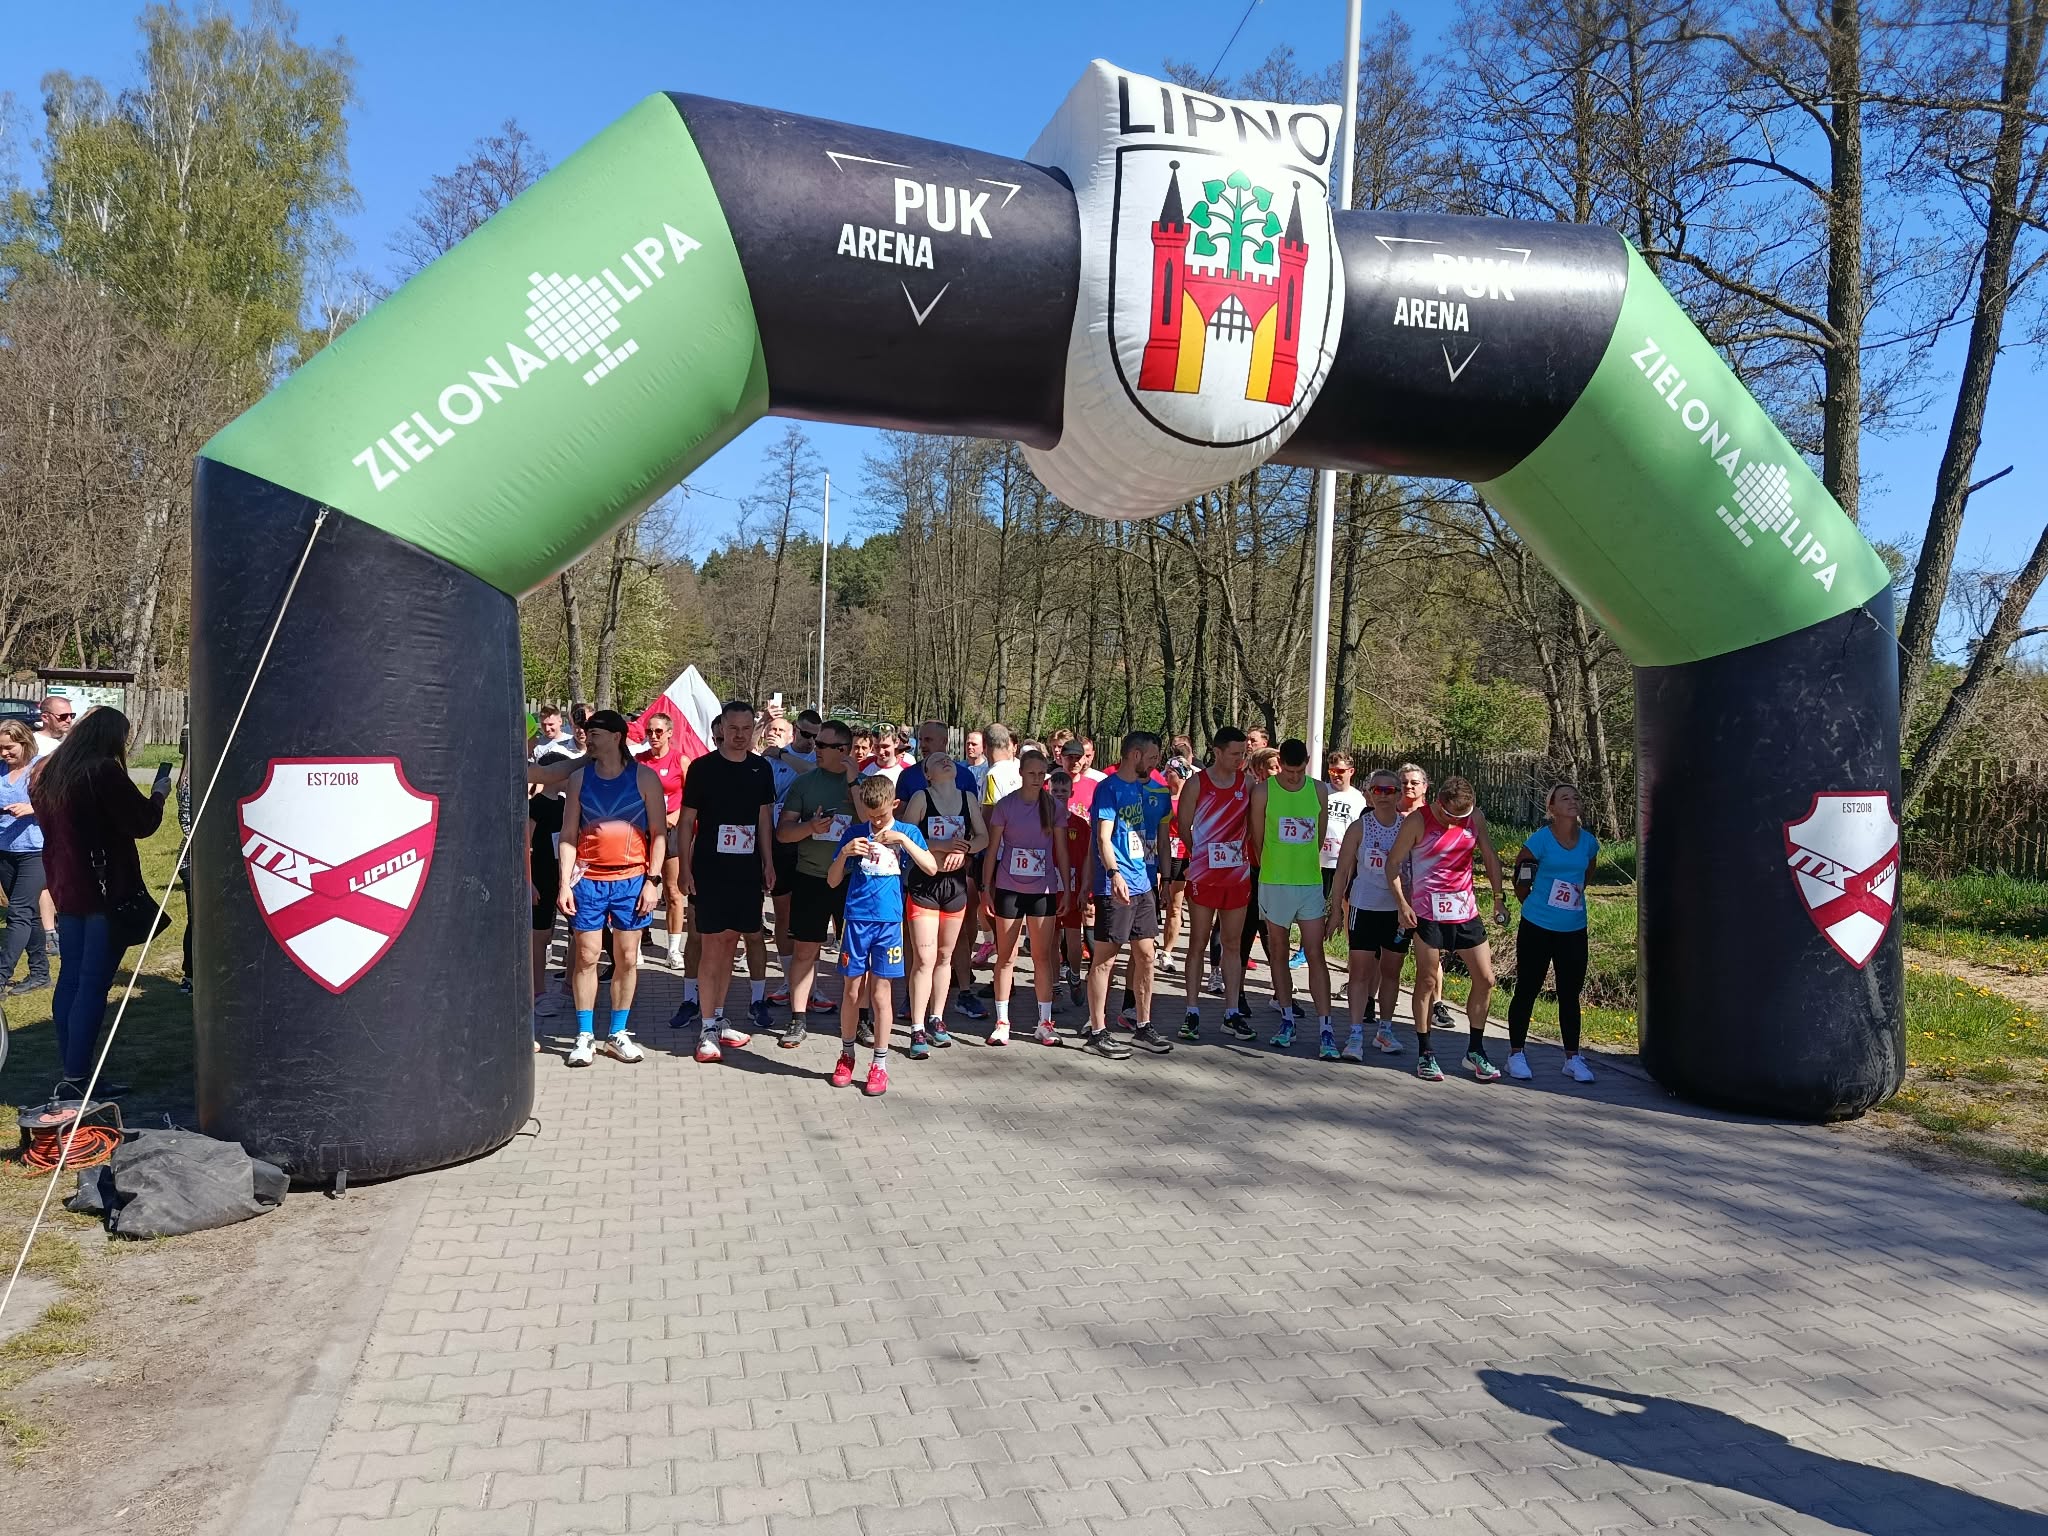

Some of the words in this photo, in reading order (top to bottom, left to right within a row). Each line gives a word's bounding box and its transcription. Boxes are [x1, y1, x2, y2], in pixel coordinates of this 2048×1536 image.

[1118, 76, 1329, 165] LIPNO
[895, 178, 992, 238] PUK
[837, 223, 934, 270] ARENA
[1433, 253, 1515, 301] PUK
[1394, 297, 1469, 332] ARENA
[352, 342, 547, 491] ZIELONA
[603, 222, 701, 304] LIPA
[1630, 337, 1741, 479] ZIELONA
[1780, 518, 1838, 592] LIPA
[307, 772, 359, 786] EST2018
[1842, 803, 1872, 814] EST2018
[933, 825, 945, 836] 21
[1284, 826, 1297, 837] 73
[723, 833, 737, 846] 31
[1323, 843, 1332, 852] 51
[241, 832, 333, 890] MX
[348, 848, 417, 892] LIPNO
[1016, 857, 1028, 869] 18
[1214, 850, 1226, 862] 34
[1369, 856, 1383, 868] 70
[1556, 889, 1571, 903] 26
[1438, 901, 1453, 913] 52
[887, 946, 902, 964] 19
